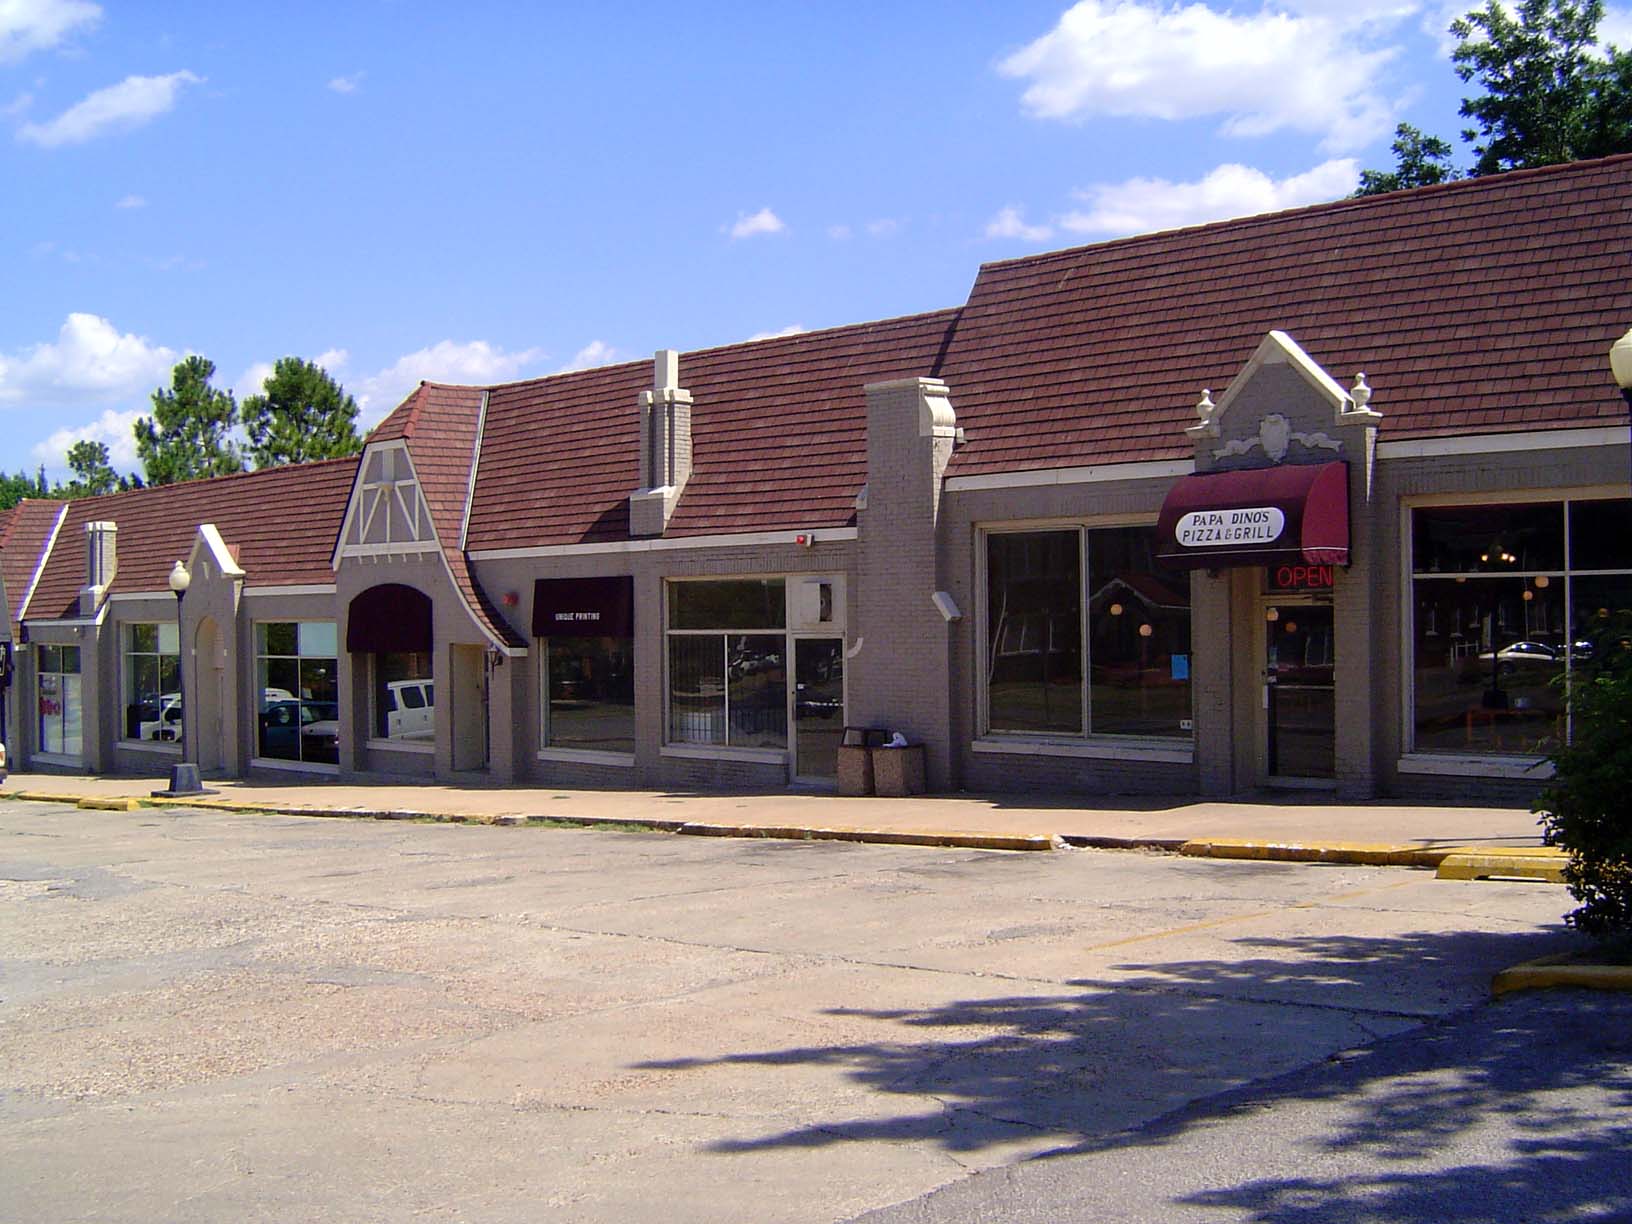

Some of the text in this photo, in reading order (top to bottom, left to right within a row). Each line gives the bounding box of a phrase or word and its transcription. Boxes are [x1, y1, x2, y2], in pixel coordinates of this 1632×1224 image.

[1193, 514, 1223, 526] PAPA
[1277, 565, 1333, 587] OPEN
[555, 612, 600, 621] UNIQUE PRINTING
